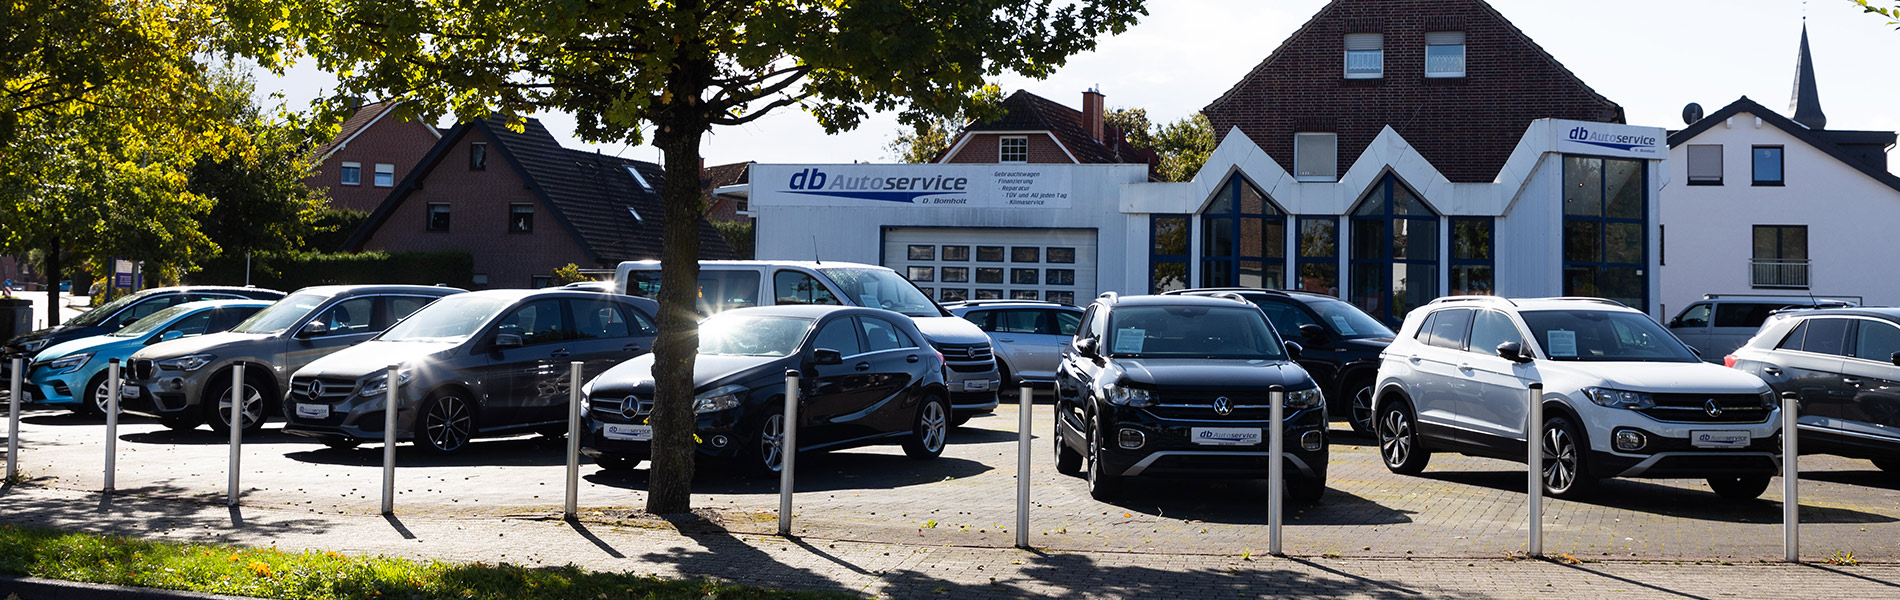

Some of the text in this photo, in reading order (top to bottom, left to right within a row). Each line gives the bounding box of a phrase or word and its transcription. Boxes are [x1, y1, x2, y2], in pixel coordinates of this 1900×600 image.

[1568, 126, 1656, 146] db Autoservice
[789, 168, 968, 190] db Autoservice
[1200, 430, 1213, 438] db
[1700, 433, 1710, 441] db
